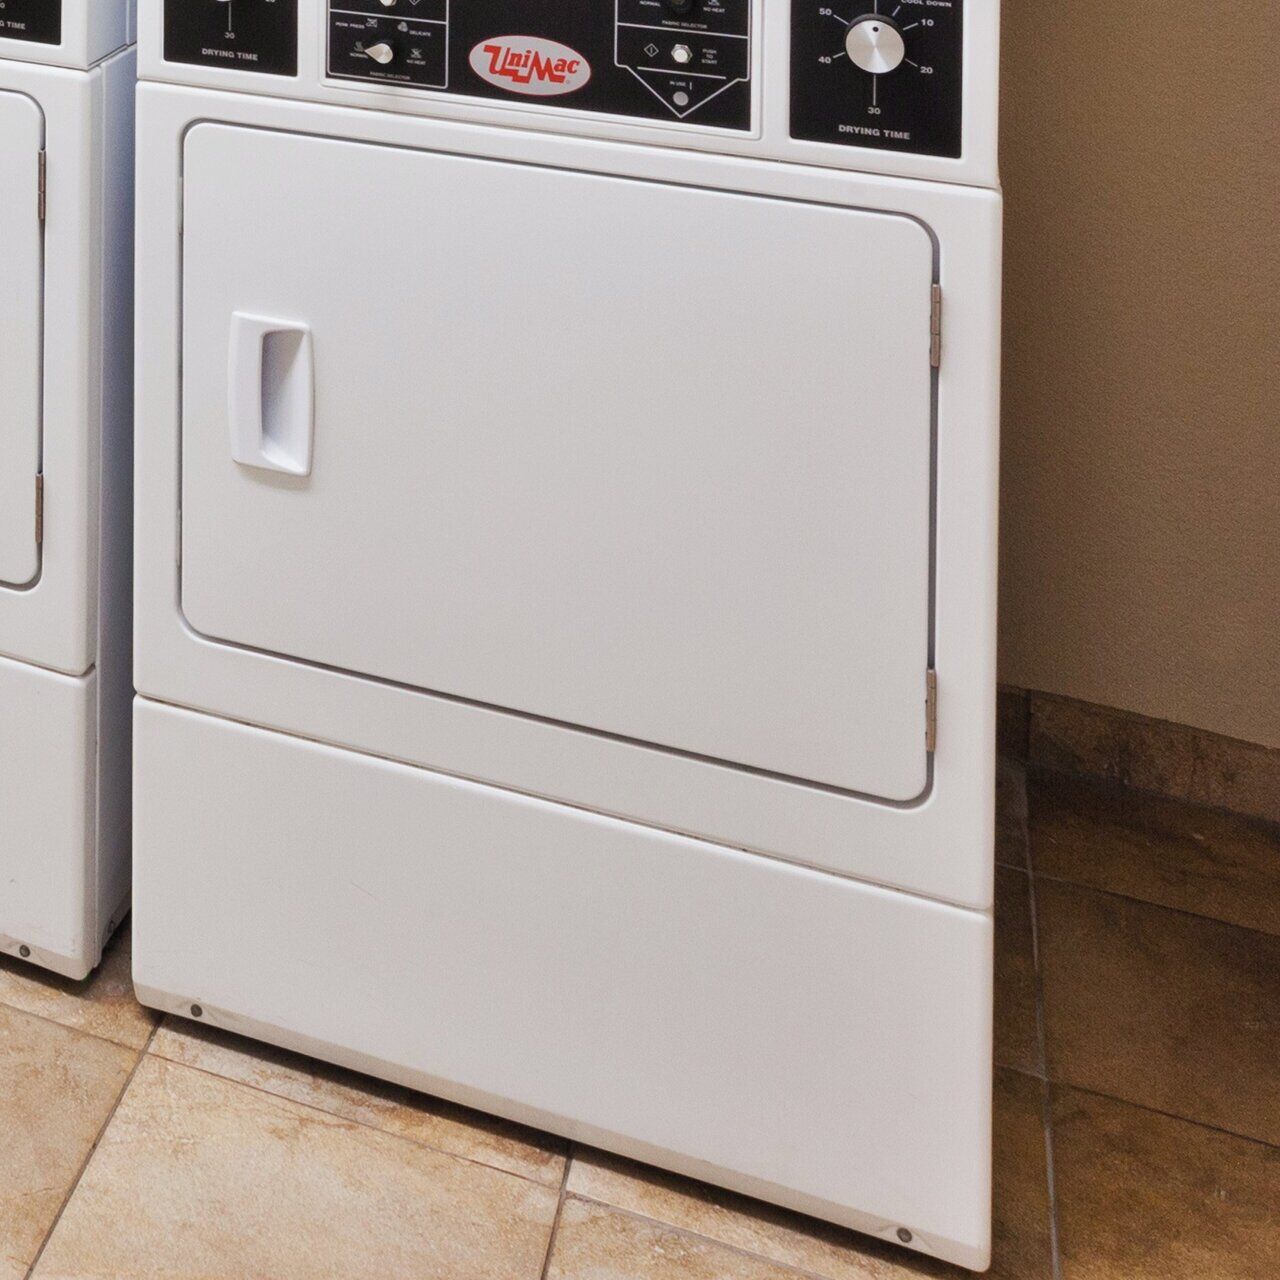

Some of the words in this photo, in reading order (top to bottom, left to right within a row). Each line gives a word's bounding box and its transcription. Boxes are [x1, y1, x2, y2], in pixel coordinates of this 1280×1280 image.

[926, 0, 952, 8] DOWN
[819, 8, 832, 16] 50
[7, 21, 26, 30] TIME
[921, 19, 934, 27] 10
[202, 48, 234, 58] DRYING
[237, 52, 259, 61] TIME
[483, 44, 580, 84] UniMac
[818, 56, 831, 64] 40
[920, 66, 933, 74] 20
[867, 106, 881, 115] 30
[838, 124, 880, 136] DRYING
[883, 130, 910, 140] TIME
